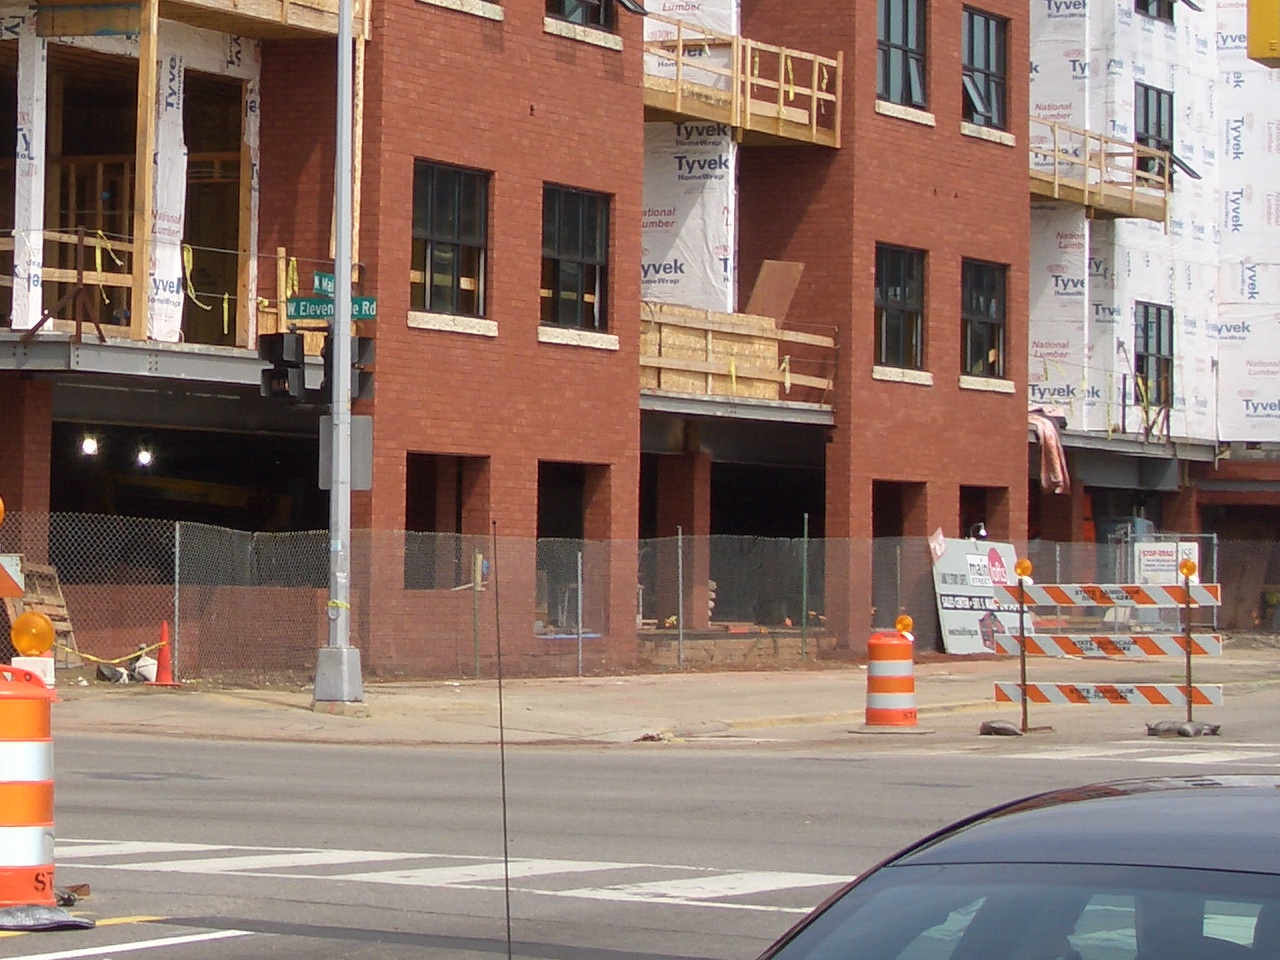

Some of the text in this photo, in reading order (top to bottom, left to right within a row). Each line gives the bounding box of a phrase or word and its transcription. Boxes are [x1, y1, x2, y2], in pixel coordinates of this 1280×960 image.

[662, 3, 701, 12] Lumber
[165, 56, 177, 112] Tyve
[673, 122, 729, 139] Tyvek
[1230, 117, 1244, 161] Tyvek
[674, 155, 730, 174] Tyvek
[677, 173, 725, 182] HomeWrap
[641, 207, 676, 217] ational
[1230, 188, 1243, 233] Tyvek
[642, 220, 675, 228] umber
[641, 259, 685, 278] yvek
[1052, 275, 1085, 290] Tyve
[1245, 265, 1260, 300] yvek
[300, 301, 334, 316] Eleven
[362, 301, 377, 315] Rd
[1217, 321, 1252, 335] yvek
[1031, 340, 1069, 349] National
[1034, 350, 1069, 359] Lumber
[1029, 384, 1076, 400] Tyvek
